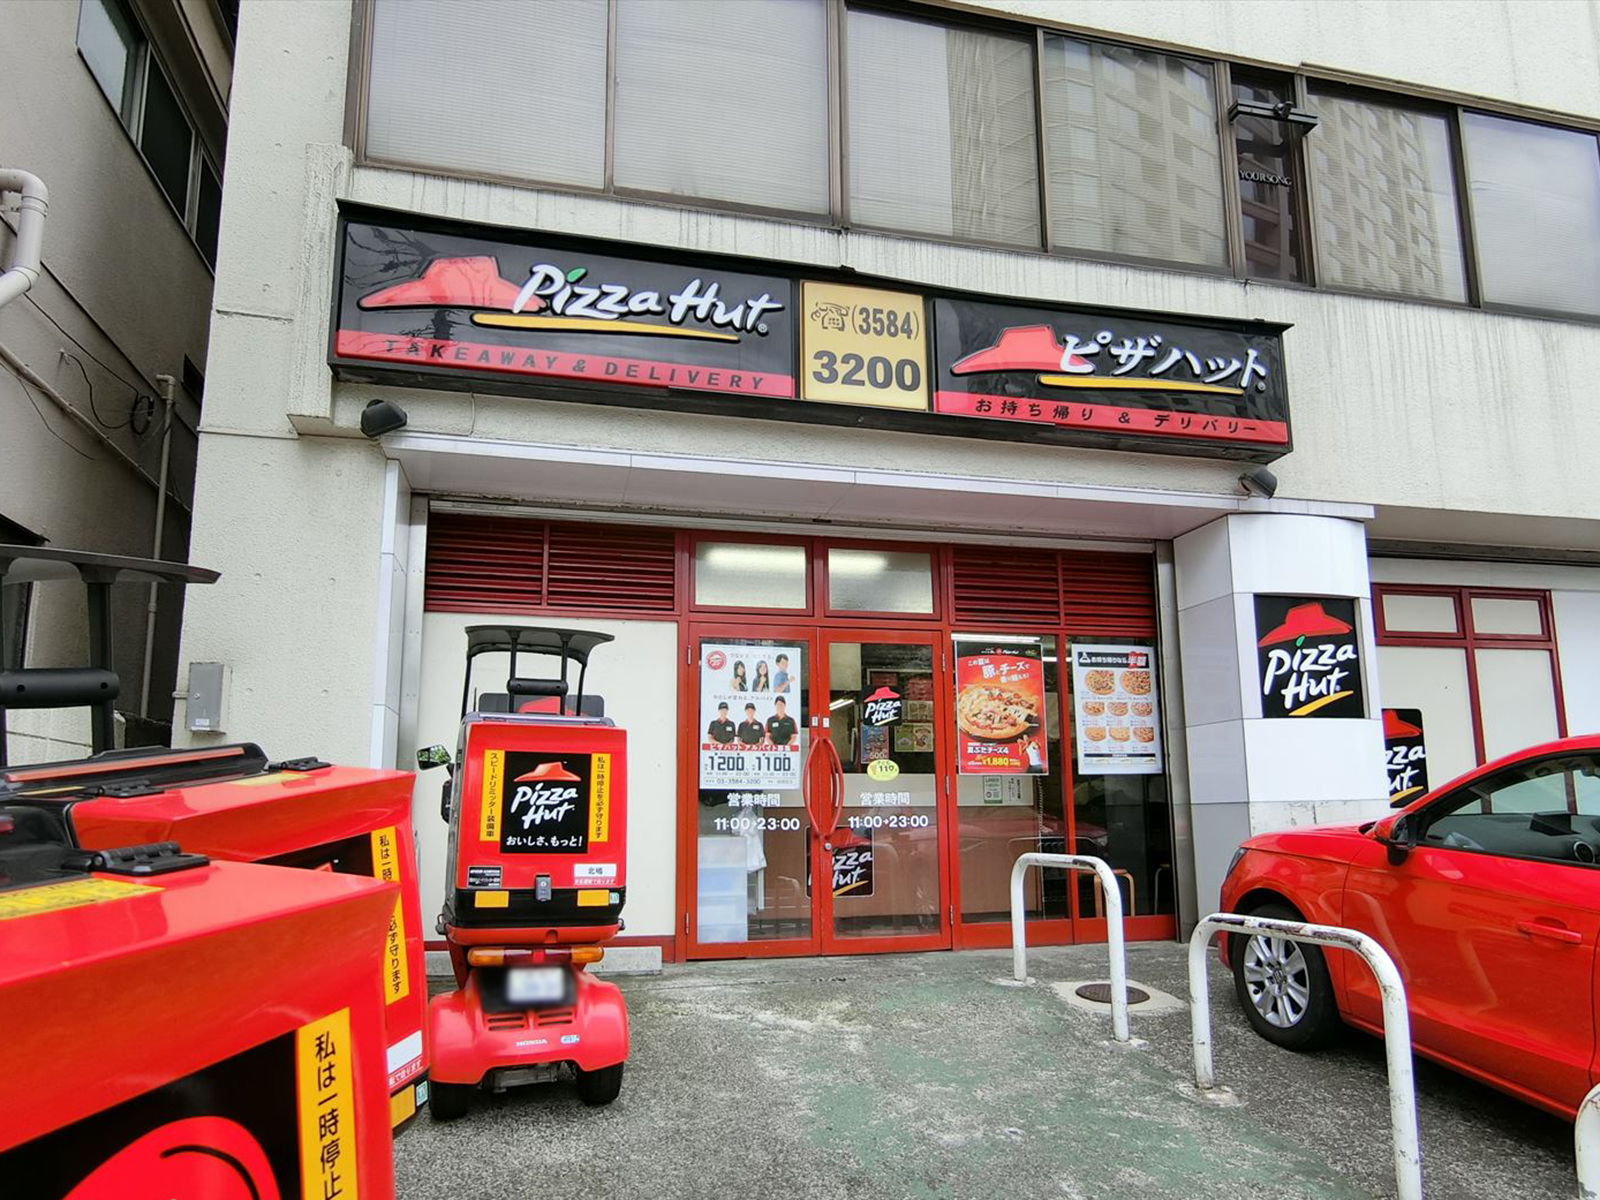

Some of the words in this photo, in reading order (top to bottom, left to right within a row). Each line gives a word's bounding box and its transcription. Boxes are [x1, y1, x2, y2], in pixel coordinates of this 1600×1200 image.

[513, 264, 663, 320] Pizza
[384, 339, 559, 369] TAKEAWAY
[572, 358, 587, 373] &
[604, 363, 764, 391] DELIVERY
[812, 350, 921, 392] 3200
[1060, 331, 1267, 389] ピザハット
[975, 398, 1094, 420] お持ち帰り
[1118, 411, 1131, 424] &
[1153, 413, 1257, 435] デリバリー
[1263, 635, 1357, 695] Pizza
[1281, 667, 1349, 709] Hut
[864, 699, 902, 719] Pizza
[871, 709, 898, 724] Hut
[709, 756, 745, 771] 1200
[755, 757, 791, 771] 1100
[1386, 745, 1426, 770] zza
[1388, 766, 1420, 791] ut
[511, 782, 578, 813] Pizza
[727, 793, 780, 807] 営業時間
[859, 792, 910, 806] 営業時間
[522, 802, 573, 829] Hut
[757, 817, 800, 830] 23:00
[889, 815, 929, 828] 23:00
[315, 1031, 343, 1200] 私は一時停止
